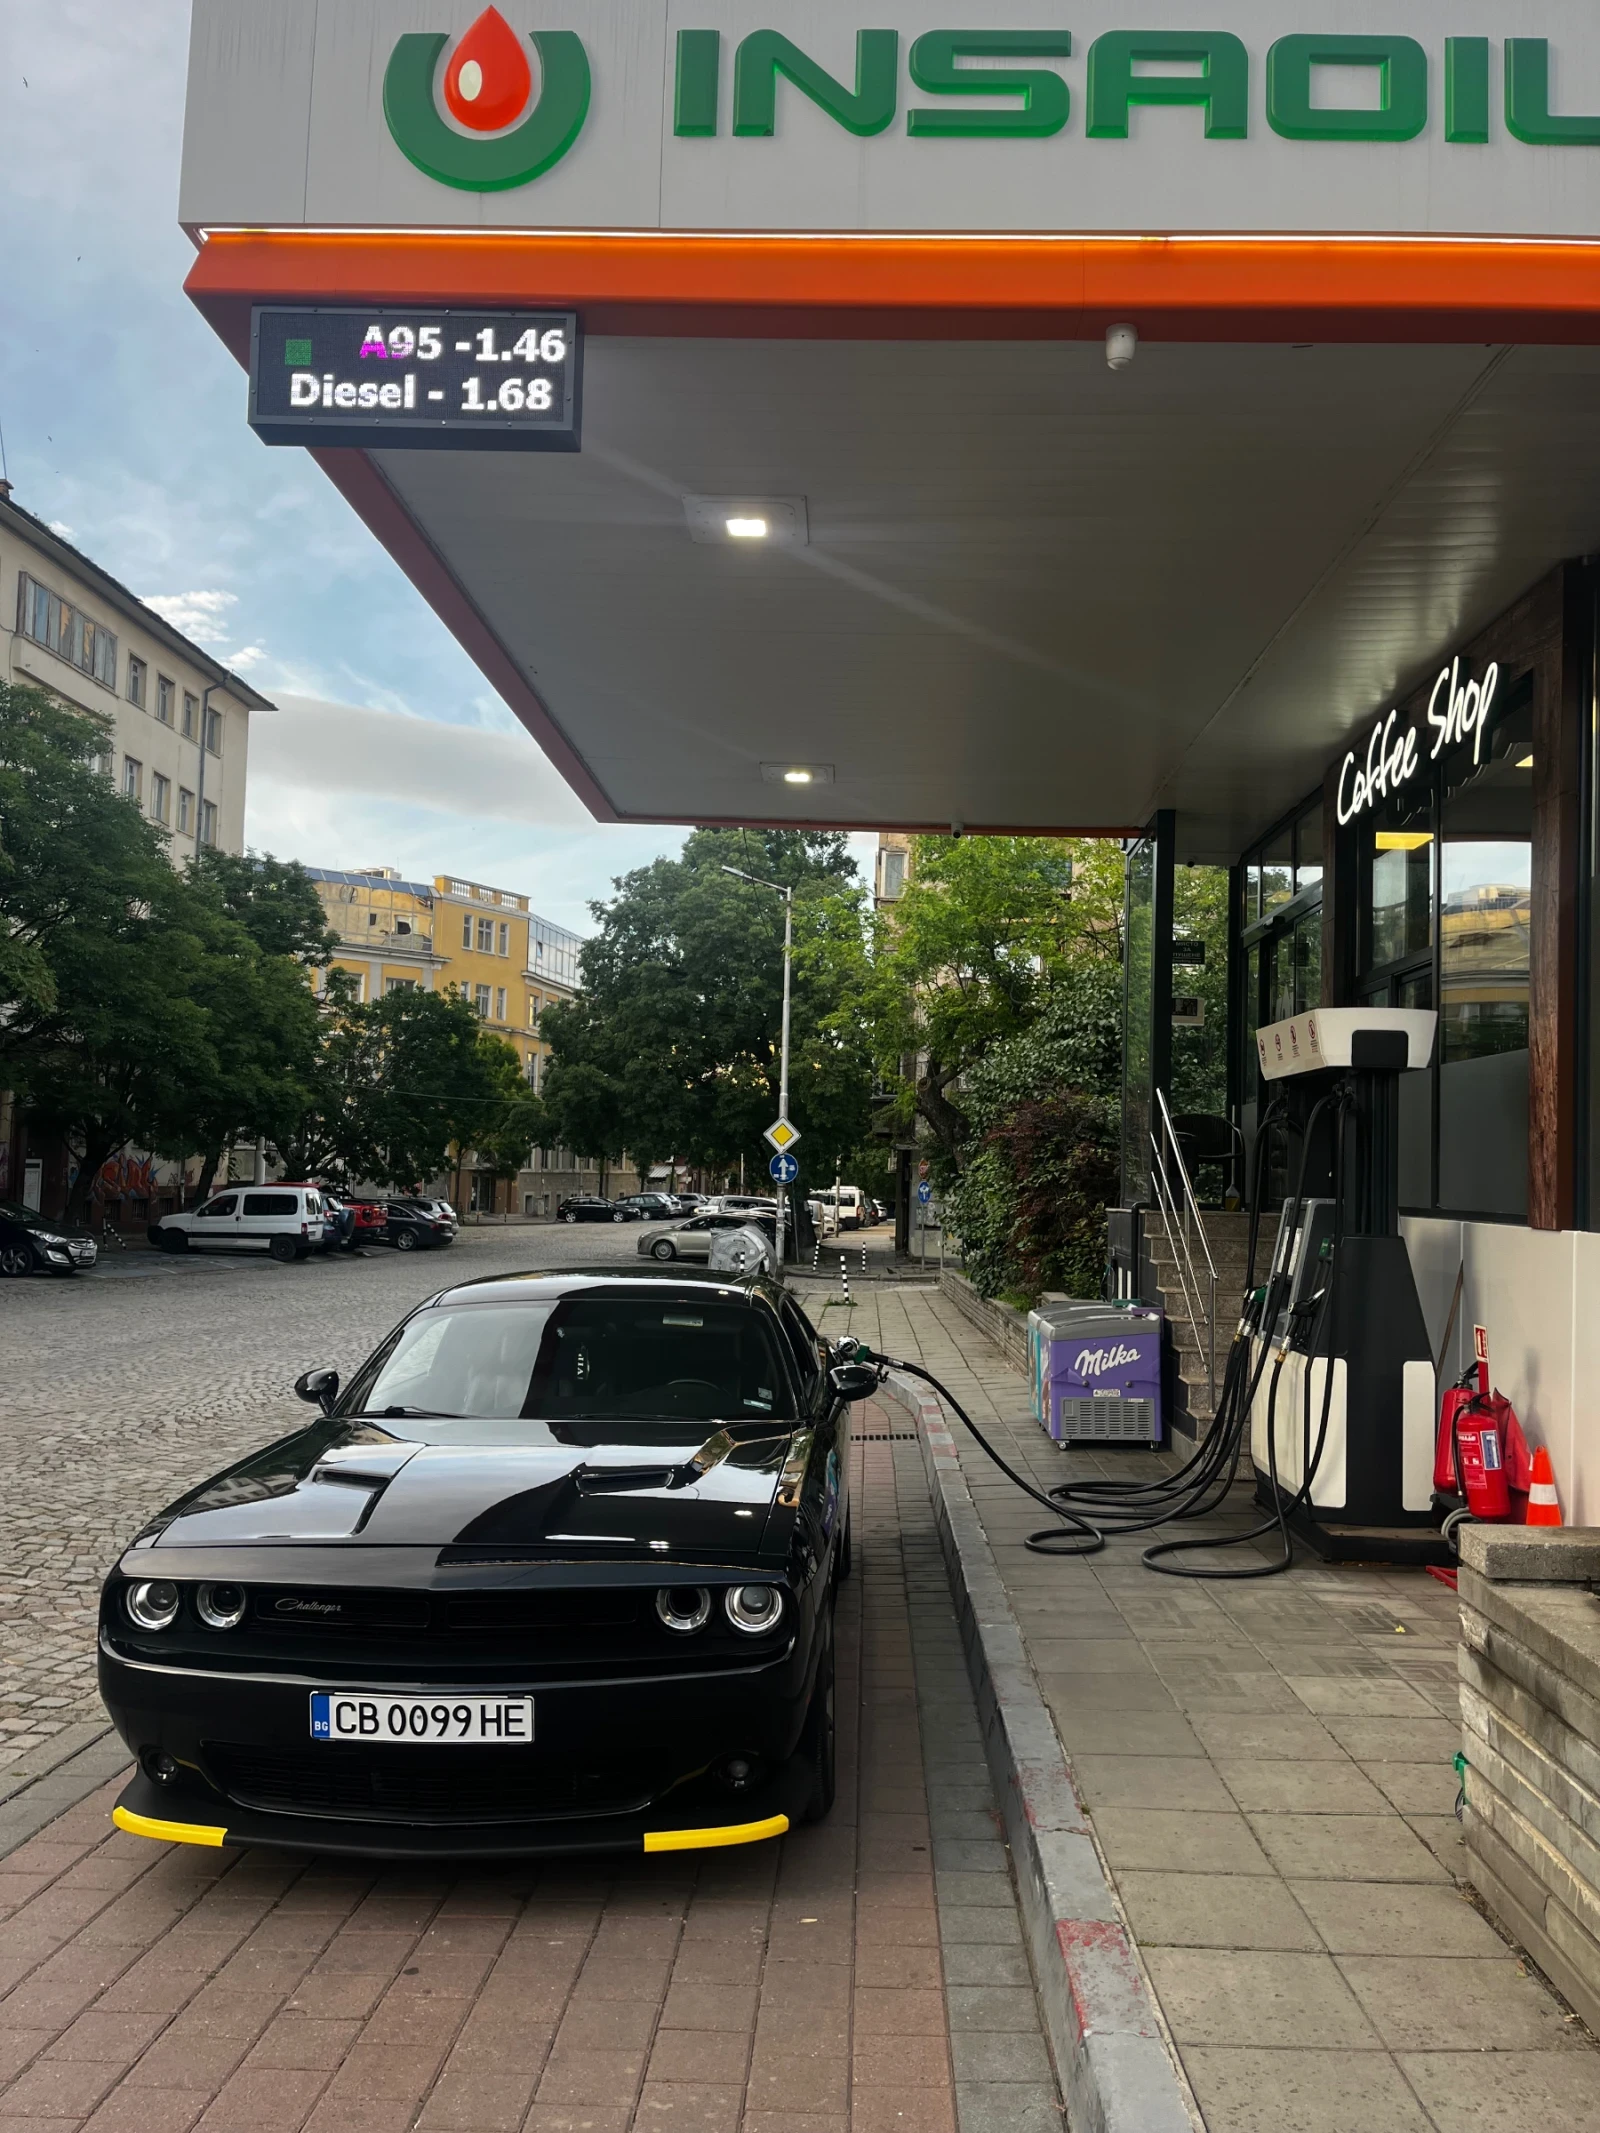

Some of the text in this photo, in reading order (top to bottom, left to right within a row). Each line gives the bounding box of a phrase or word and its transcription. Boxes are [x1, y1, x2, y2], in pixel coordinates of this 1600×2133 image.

[674, 29, 1600, 146] INSAOIL
[360, 326, 443, 360] A95
[290, 372, 553, 411] Diesel - 1.68
[1337, 656, 1498, 826] Coffee Shop
[1074, 1344, 1141, 1377] Milka
[275, 1598, 342, 1614] Challenger
[314, 1722, 329, 1731] BG
[335, 1701, 526, 1737] CB 0099 HE
